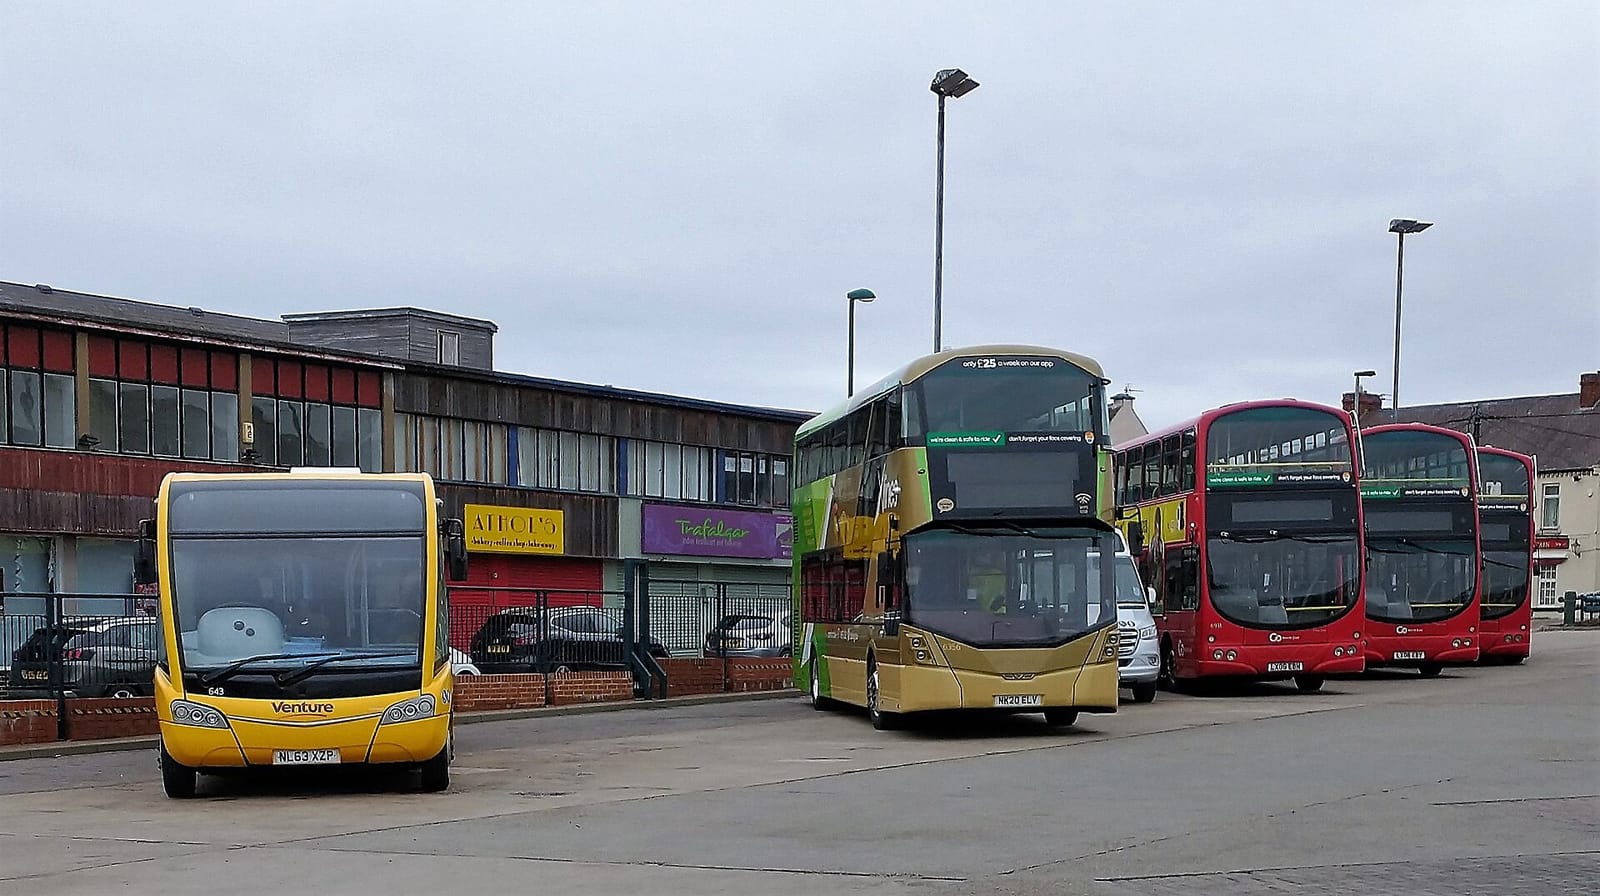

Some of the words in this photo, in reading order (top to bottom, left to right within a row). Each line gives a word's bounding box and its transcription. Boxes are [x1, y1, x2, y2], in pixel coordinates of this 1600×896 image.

[977, 359, 997, 368] £25
[472, 513, 557, 535] ATHOL'S
[675, 518, 750, 538] Trafalgar
[208, 687, 225, 695] 643
[998, 695, 1020, 705] NK20
[1021, 695, 1038, 704] ELV
[271, 701, 334, 713] Venture
[279, 751, 309, 762] NL63
[311, 750, 334, 760] XZP
